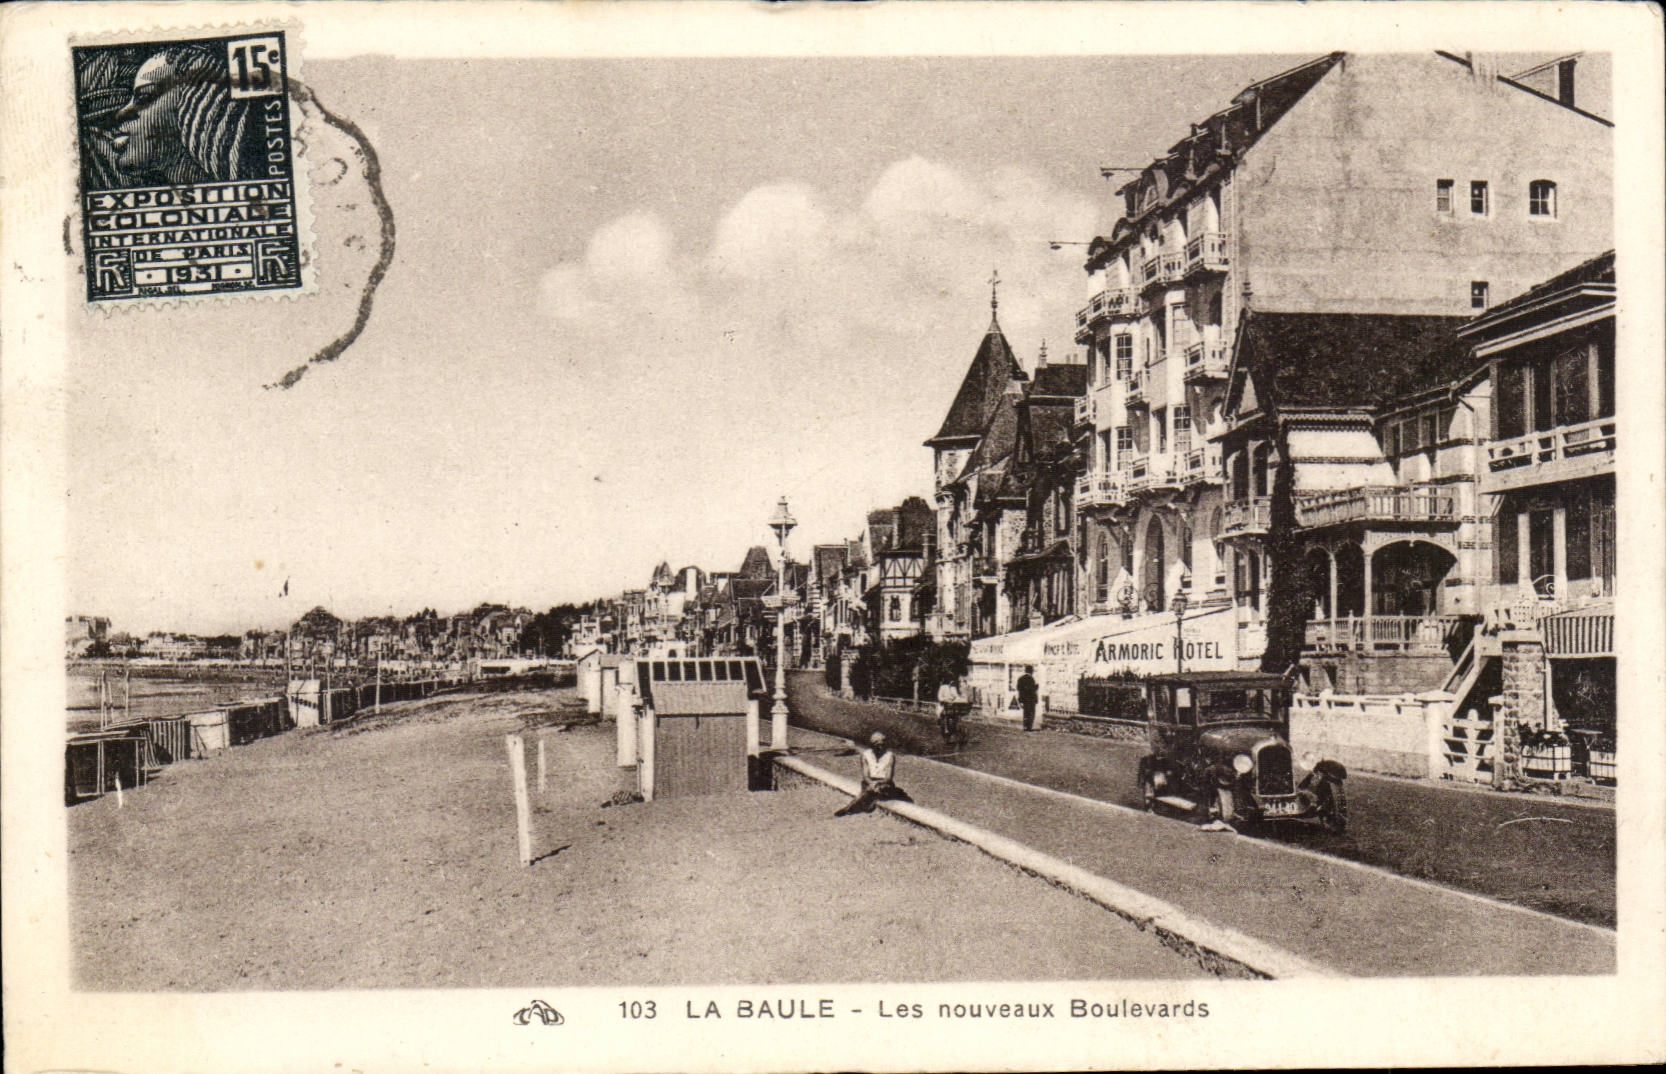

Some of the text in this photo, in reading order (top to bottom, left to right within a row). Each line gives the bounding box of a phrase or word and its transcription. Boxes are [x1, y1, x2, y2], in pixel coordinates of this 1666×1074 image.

[264, 100, 286, 176] POSTES
[90, 184, 288, 209] EXPOSITION
[90, 204, 290, 231] COLONIALE
[91, 226, 290, 248] INTERNATIONALE
[136, 244, 250, 262] DE PARIS
[165, 263, 222, 284] 1931
[1094, 637, 1164, 663] ARMORIC
